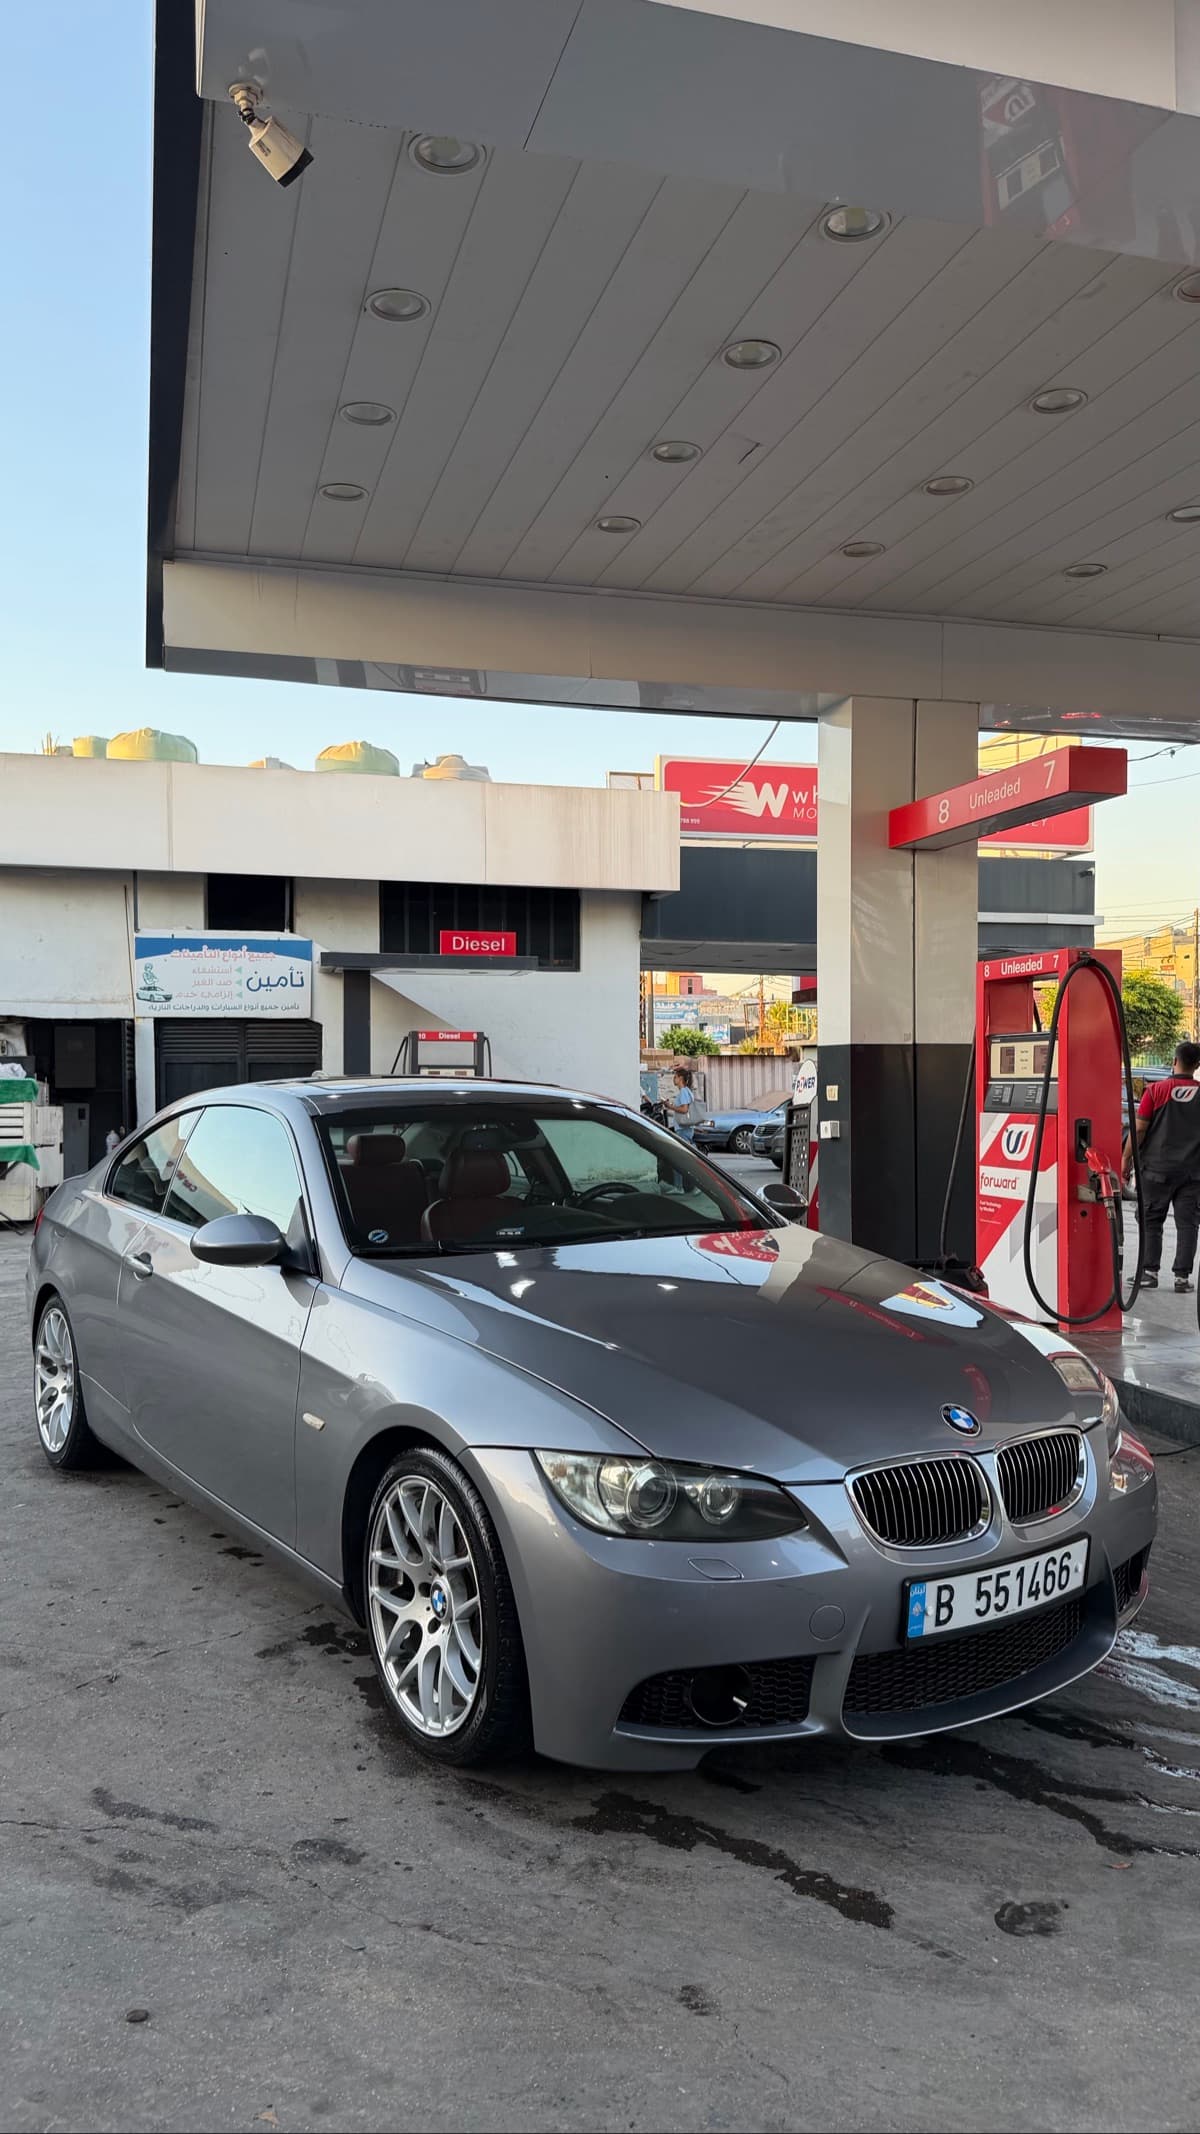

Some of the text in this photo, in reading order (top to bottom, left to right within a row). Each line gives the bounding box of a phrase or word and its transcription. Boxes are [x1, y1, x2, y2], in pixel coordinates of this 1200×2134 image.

[938, 759, 1056, 824] 8 Unleaded 7
[452, 936, 505, 951] Diesel
[984, 955, 1059, 977] 8 Unleaded 7
[246, 966, 305, 992] تأمين
[439, 1032, 461, 1040] Diesel
[980, 1172, 1017, 1190] forward
[934, 1551, 1072, 1627] B 551466
